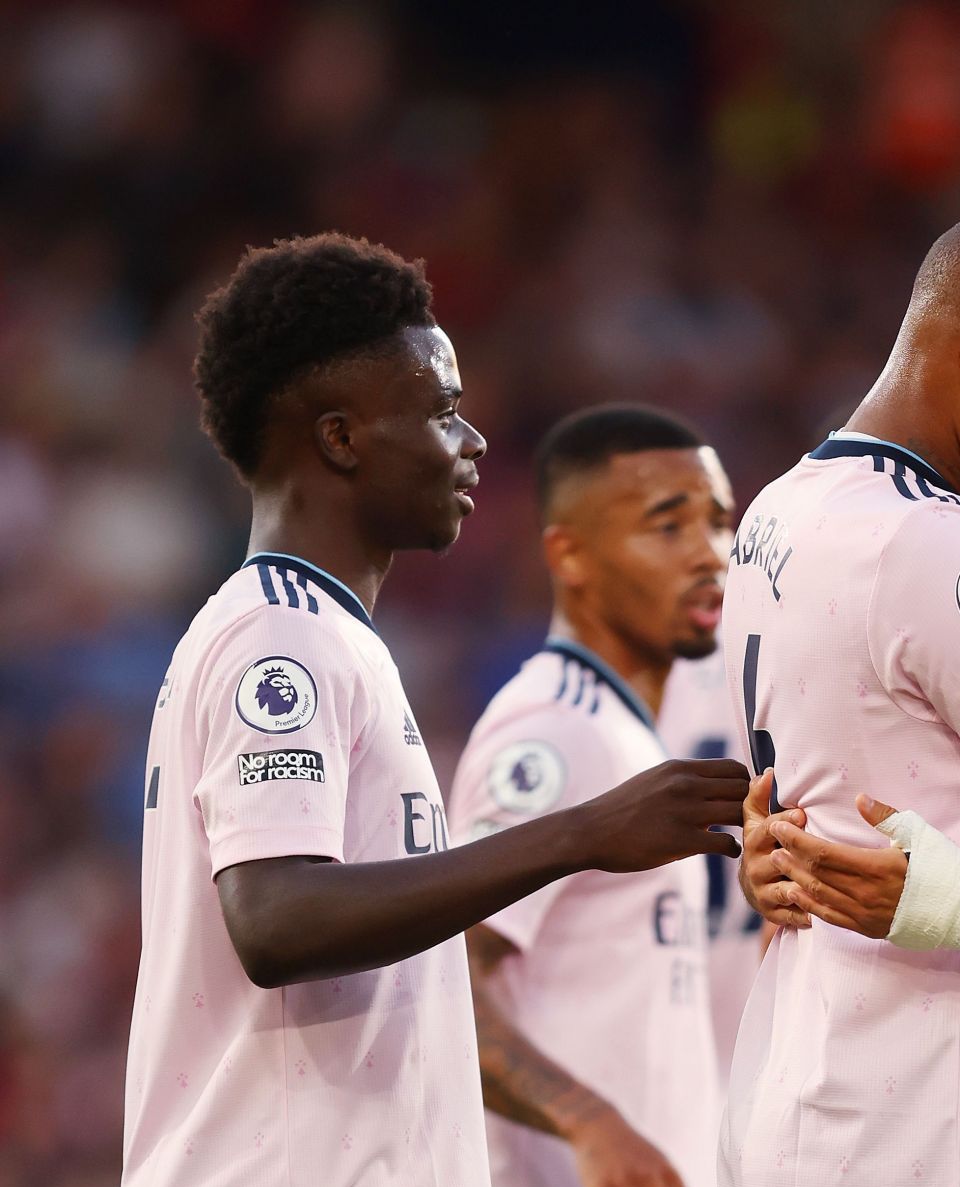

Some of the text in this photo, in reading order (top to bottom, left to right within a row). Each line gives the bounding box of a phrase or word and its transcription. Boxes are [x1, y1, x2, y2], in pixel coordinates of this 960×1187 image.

[275, 693, 309, 727] Premier League
[238, 752, 316, 771] No room
[240, 765, 324, 785] for racism
